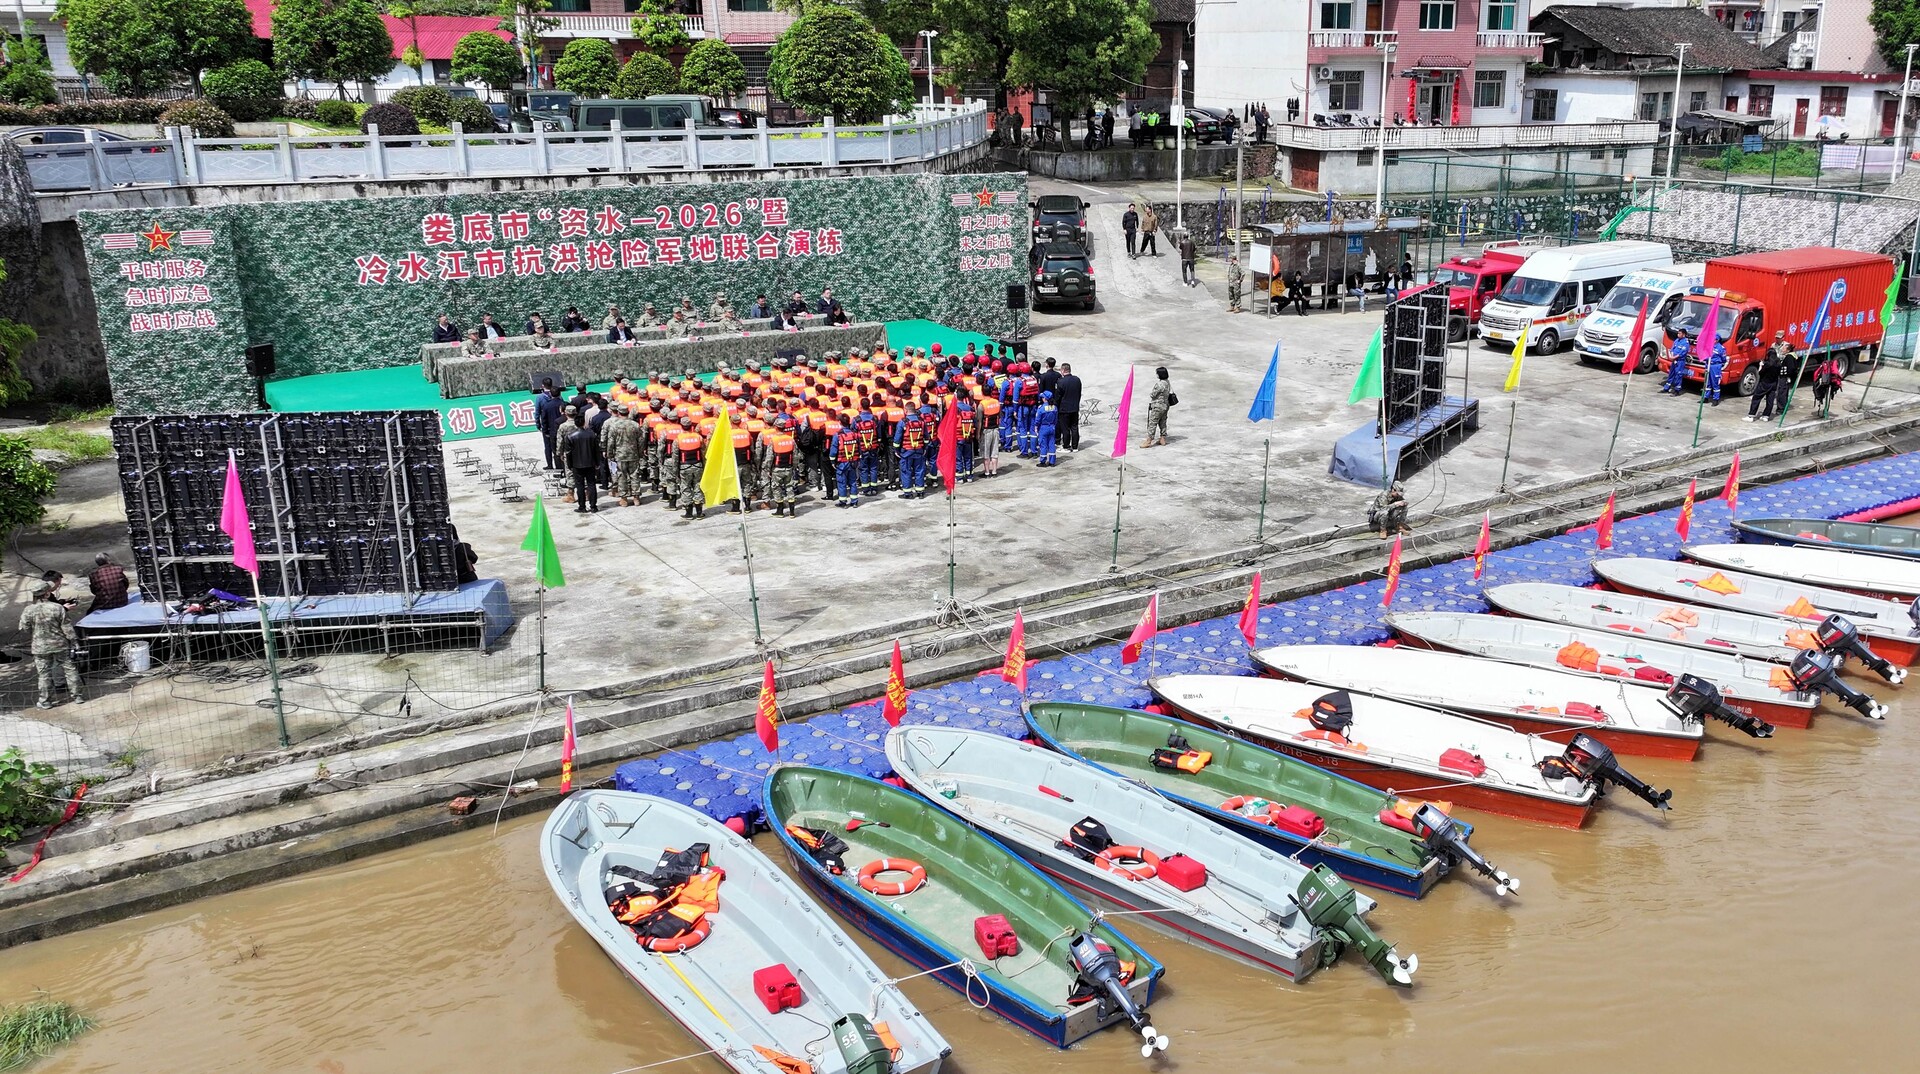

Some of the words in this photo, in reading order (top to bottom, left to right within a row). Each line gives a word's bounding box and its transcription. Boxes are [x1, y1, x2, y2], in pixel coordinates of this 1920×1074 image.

[960, 214, 1011, 231] 召之即来
[959, 234, 1012, 251] 来之能战
[355, 228, 843, 285] 冷水江市抗洪抢险军地联合演练
[960, 253, 1012, 271] 战之必胜
[120, 259, 206, 281] 平时服务
[126, 284, 212, 307] 急时应急
[130, 309, 217, 332] 战时应战
[1594, 317, 1625, 328] BSR
[1324, 873, 1338, 885] 55
[841, 1031, 857, 1047] 55
